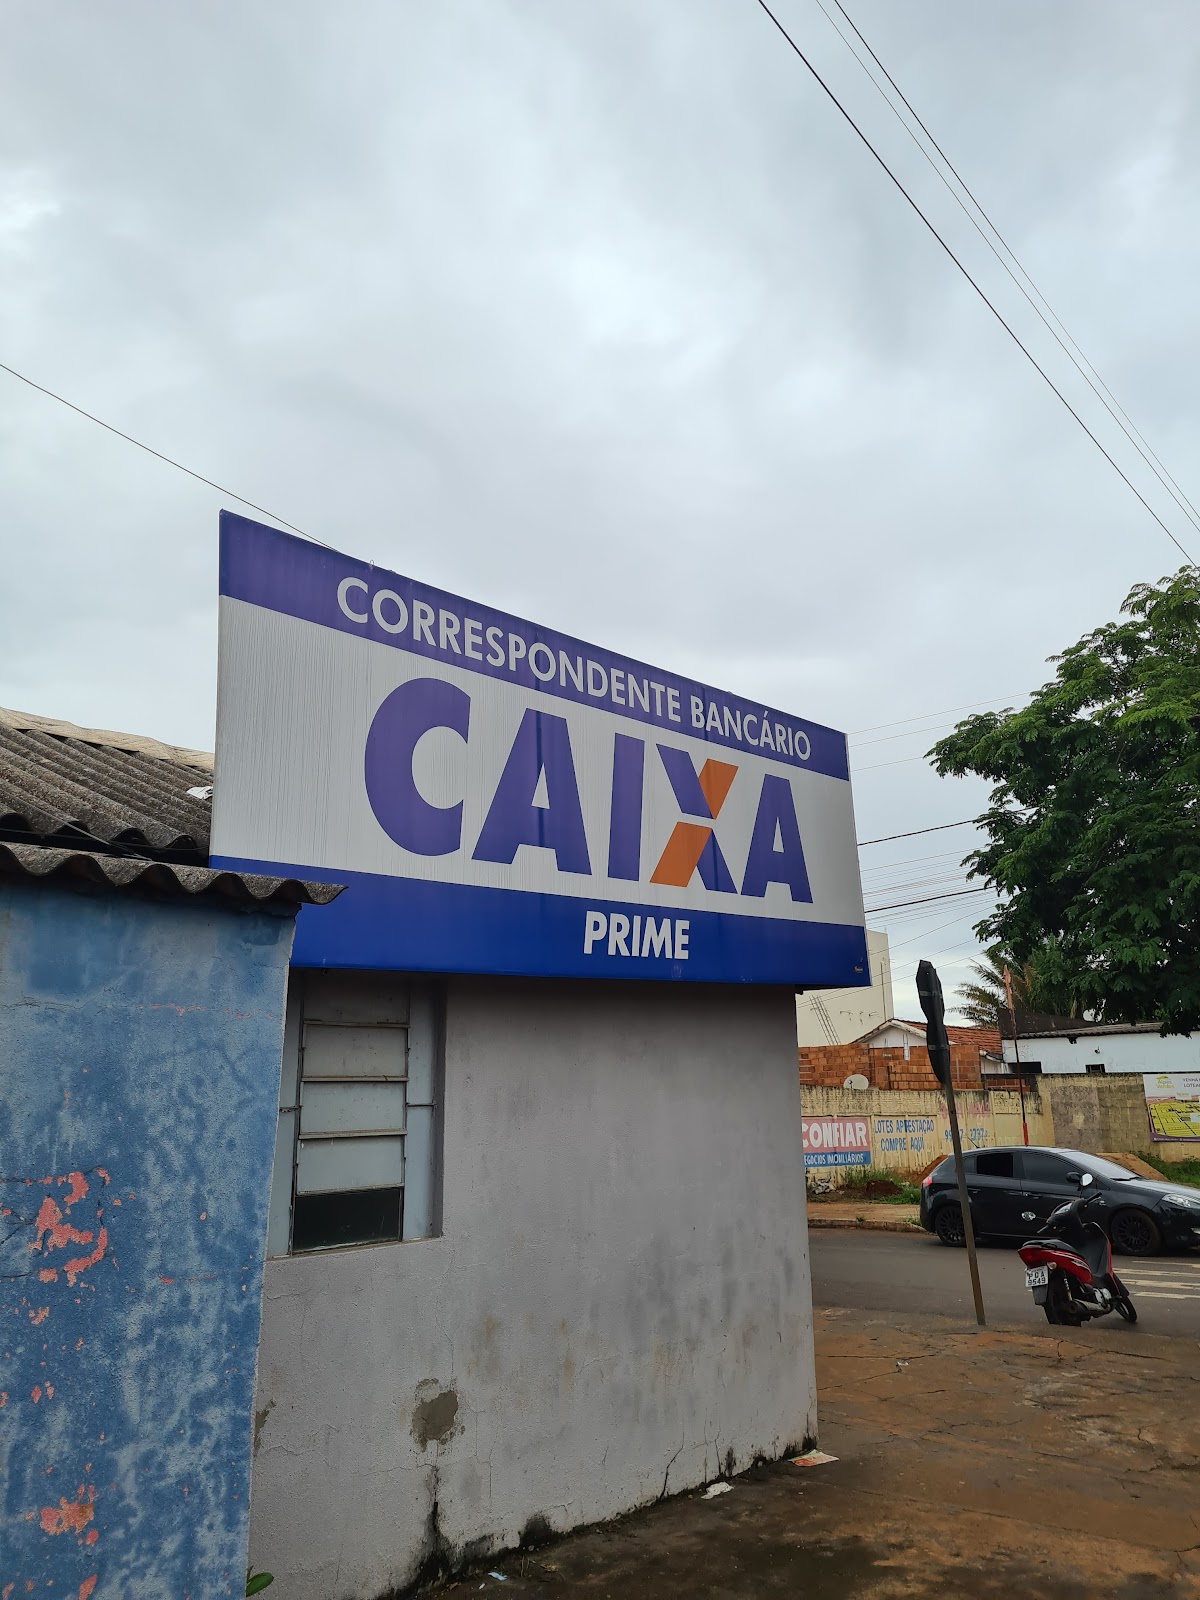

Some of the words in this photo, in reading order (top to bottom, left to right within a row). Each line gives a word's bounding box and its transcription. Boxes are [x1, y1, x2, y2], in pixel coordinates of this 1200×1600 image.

[337, 576, 681, 724] CORRESPONDENTE
[690, 695, 811, 761] BANCÁRIO
[364, 677, 813, 903] CAIXA
[584, 911, 689, 960] PRIME
[802, 1122, 868, 1148] CONFIAR
[874, 1119, 894, 1133] LOTES
[880, 1137, 907, 1151] COMPRE
[803, 1154, 827, 1165] EGOCIOS
